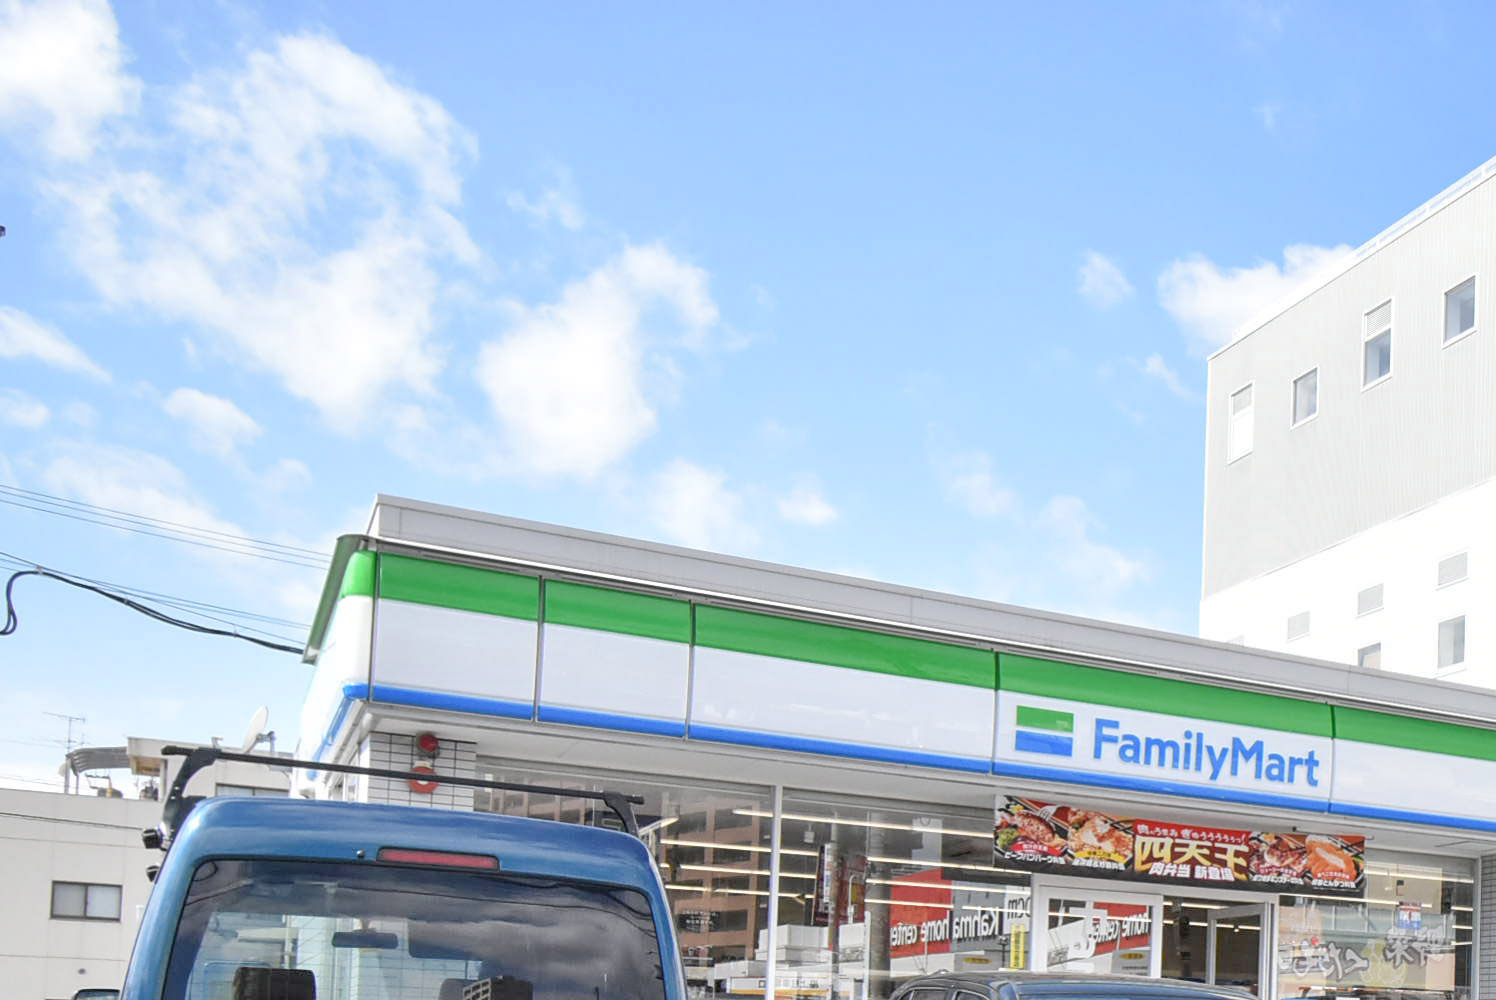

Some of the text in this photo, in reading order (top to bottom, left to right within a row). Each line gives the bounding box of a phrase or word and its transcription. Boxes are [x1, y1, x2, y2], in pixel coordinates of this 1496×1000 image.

[1093, 717, 1320, 788] FamilyMart
[1134, 834, 1249, 880] 四天王
